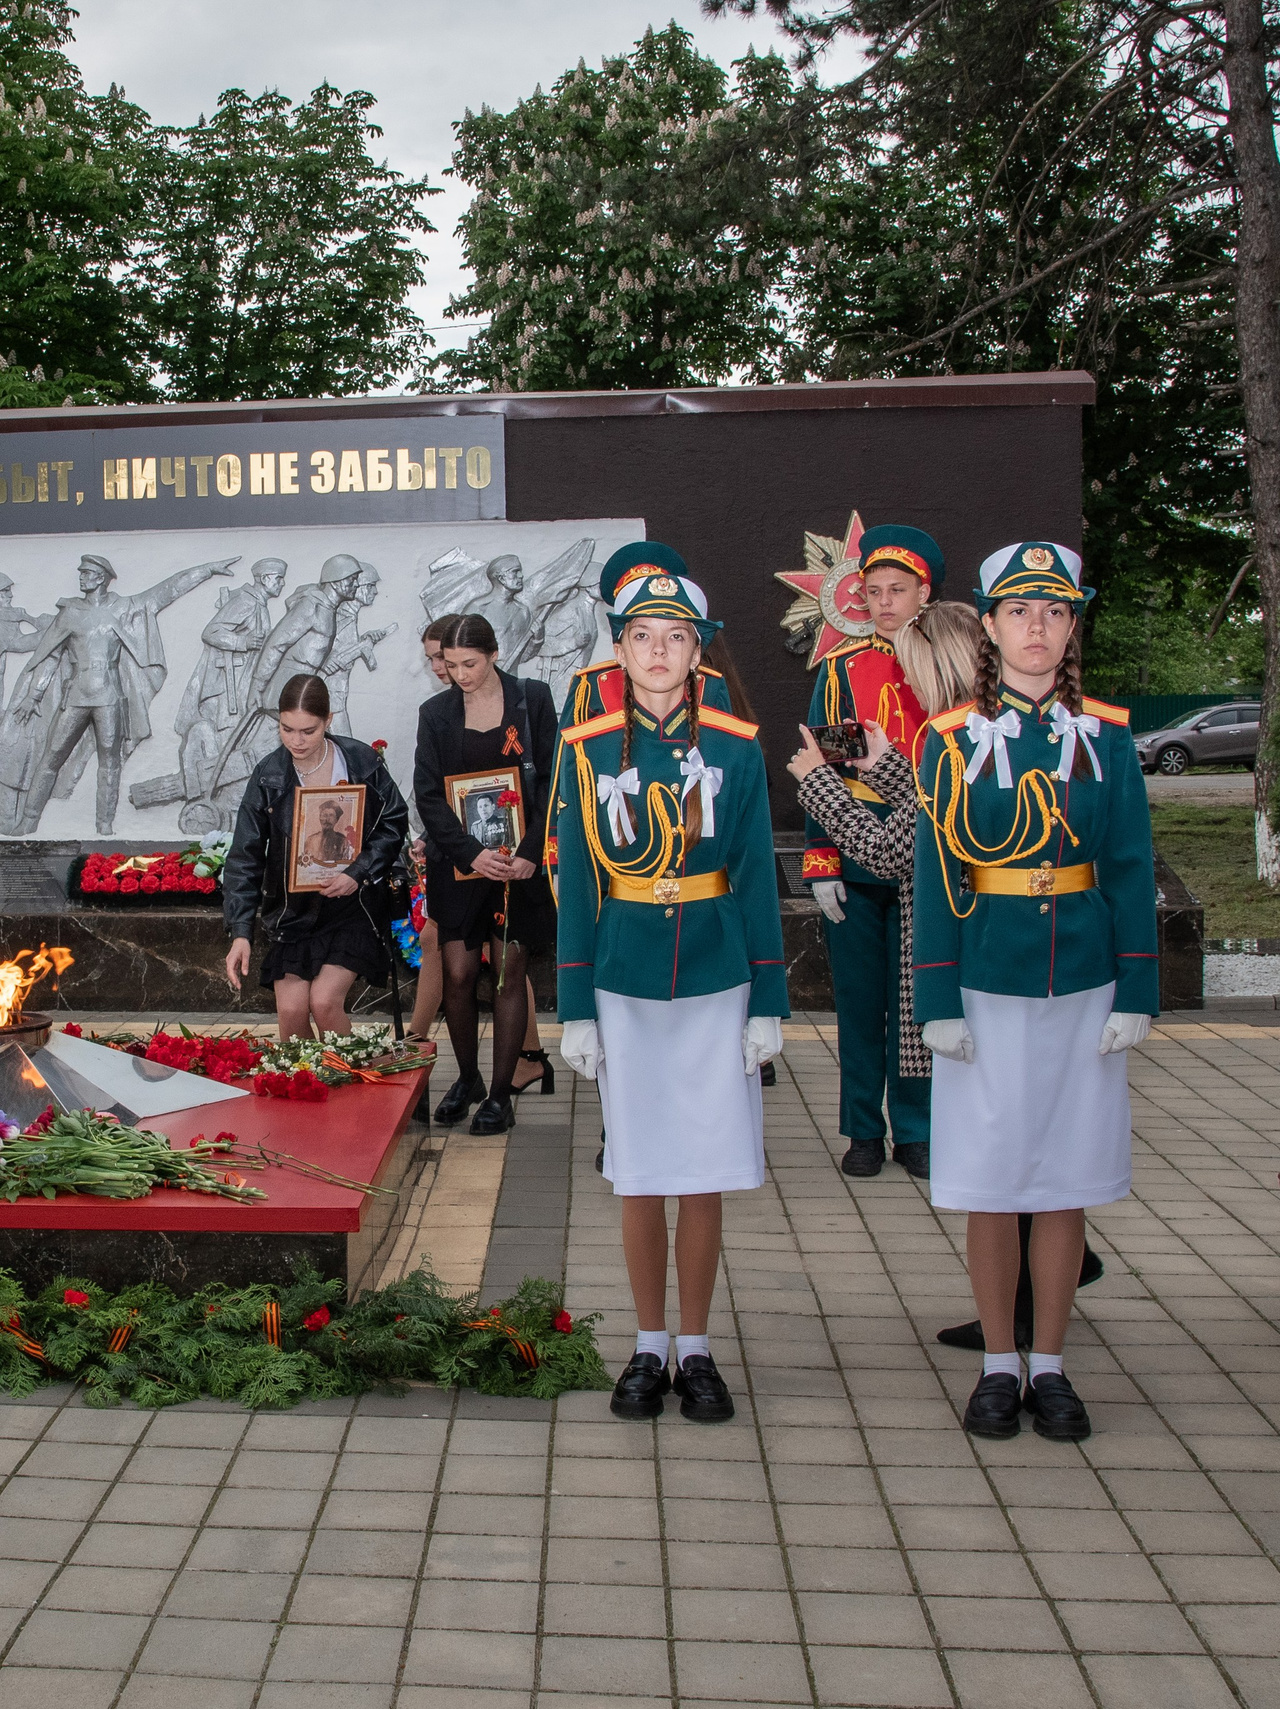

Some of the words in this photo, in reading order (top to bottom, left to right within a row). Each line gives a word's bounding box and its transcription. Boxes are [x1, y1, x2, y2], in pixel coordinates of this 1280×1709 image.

[102, 453, 242, 501] НИЧТО
[249, 451, 300, 495] НЕ
[310, 445, 492, 495] ЗАБЫТО
